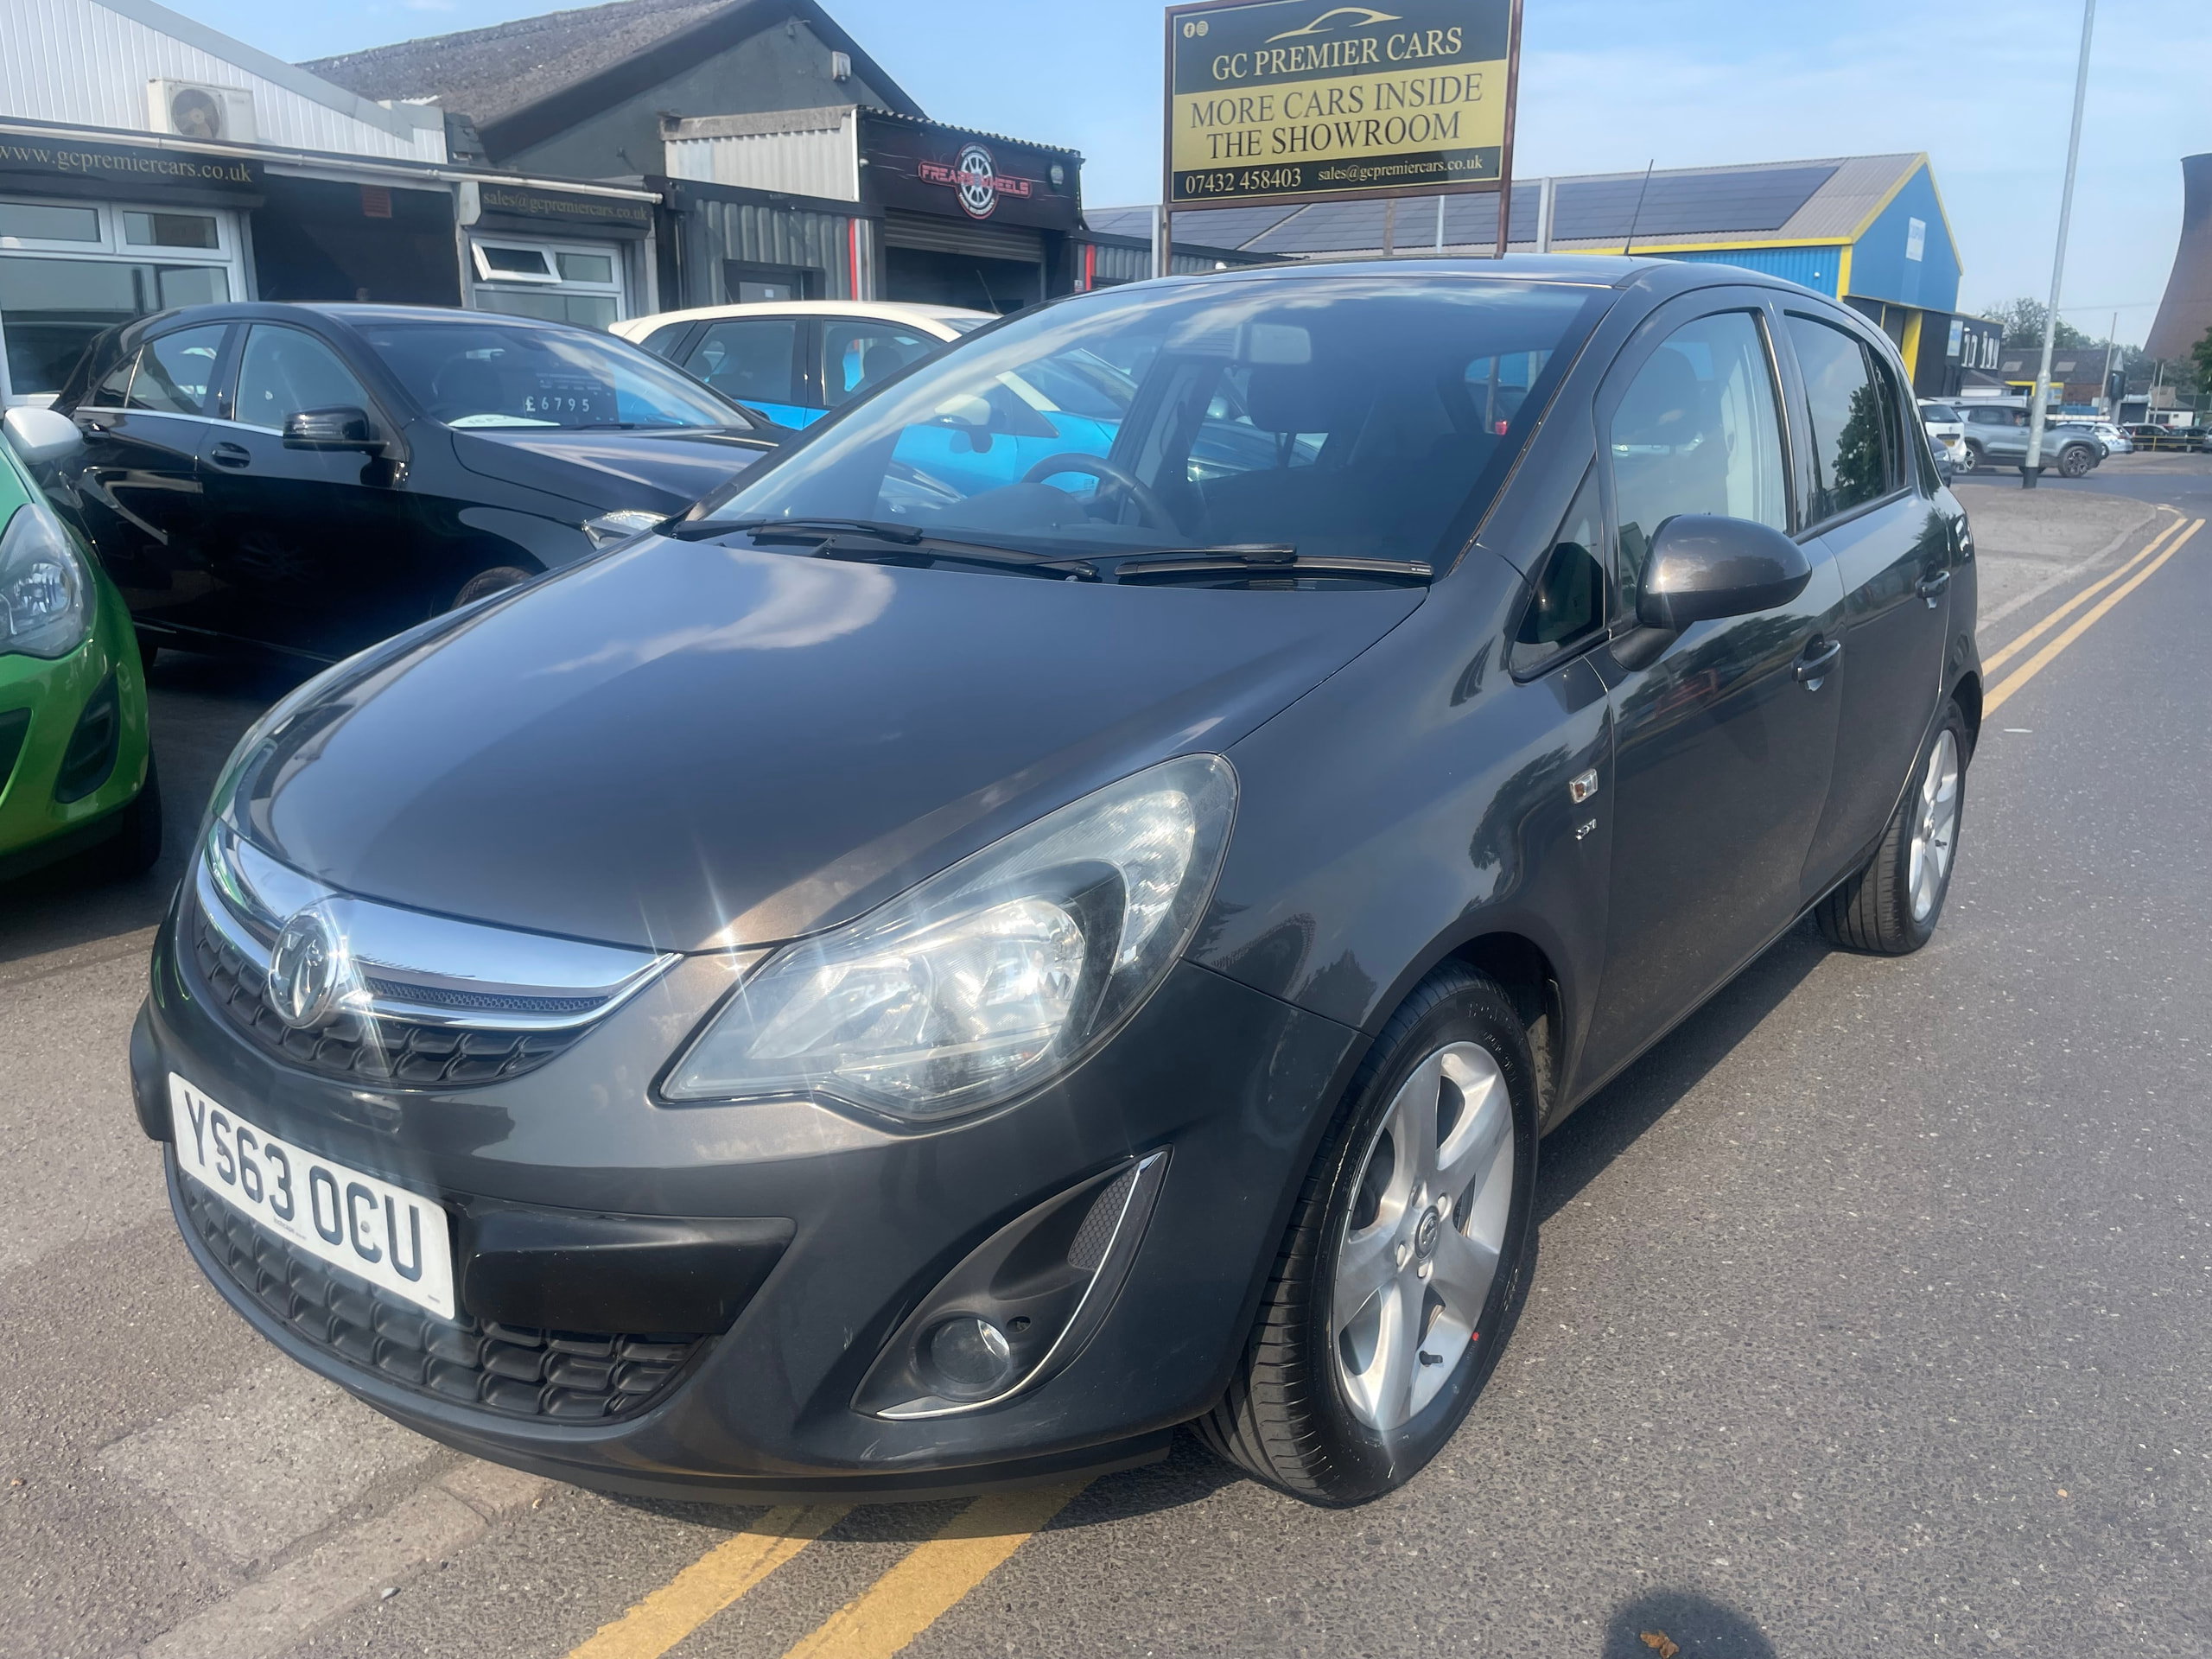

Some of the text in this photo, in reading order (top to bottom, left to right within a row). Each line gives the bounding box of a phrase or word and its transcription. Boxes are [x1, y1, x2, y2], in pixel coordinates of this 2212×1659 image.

[1211, 27, 1463, 80] GC PREMIER CARS
[1190, 73, 1484, 129] MORE CARS INSIDE
[1206, 111, 1462, 160] THE SHOWROOM
[1185, 154, 1484, 194] 07432 458403 sales@gcpremiercars.co.uk
[483, 189, 648, 220] sales@gcpremiercars.co.uk
[184, 1090, 423, 1283] YS63 OCU
